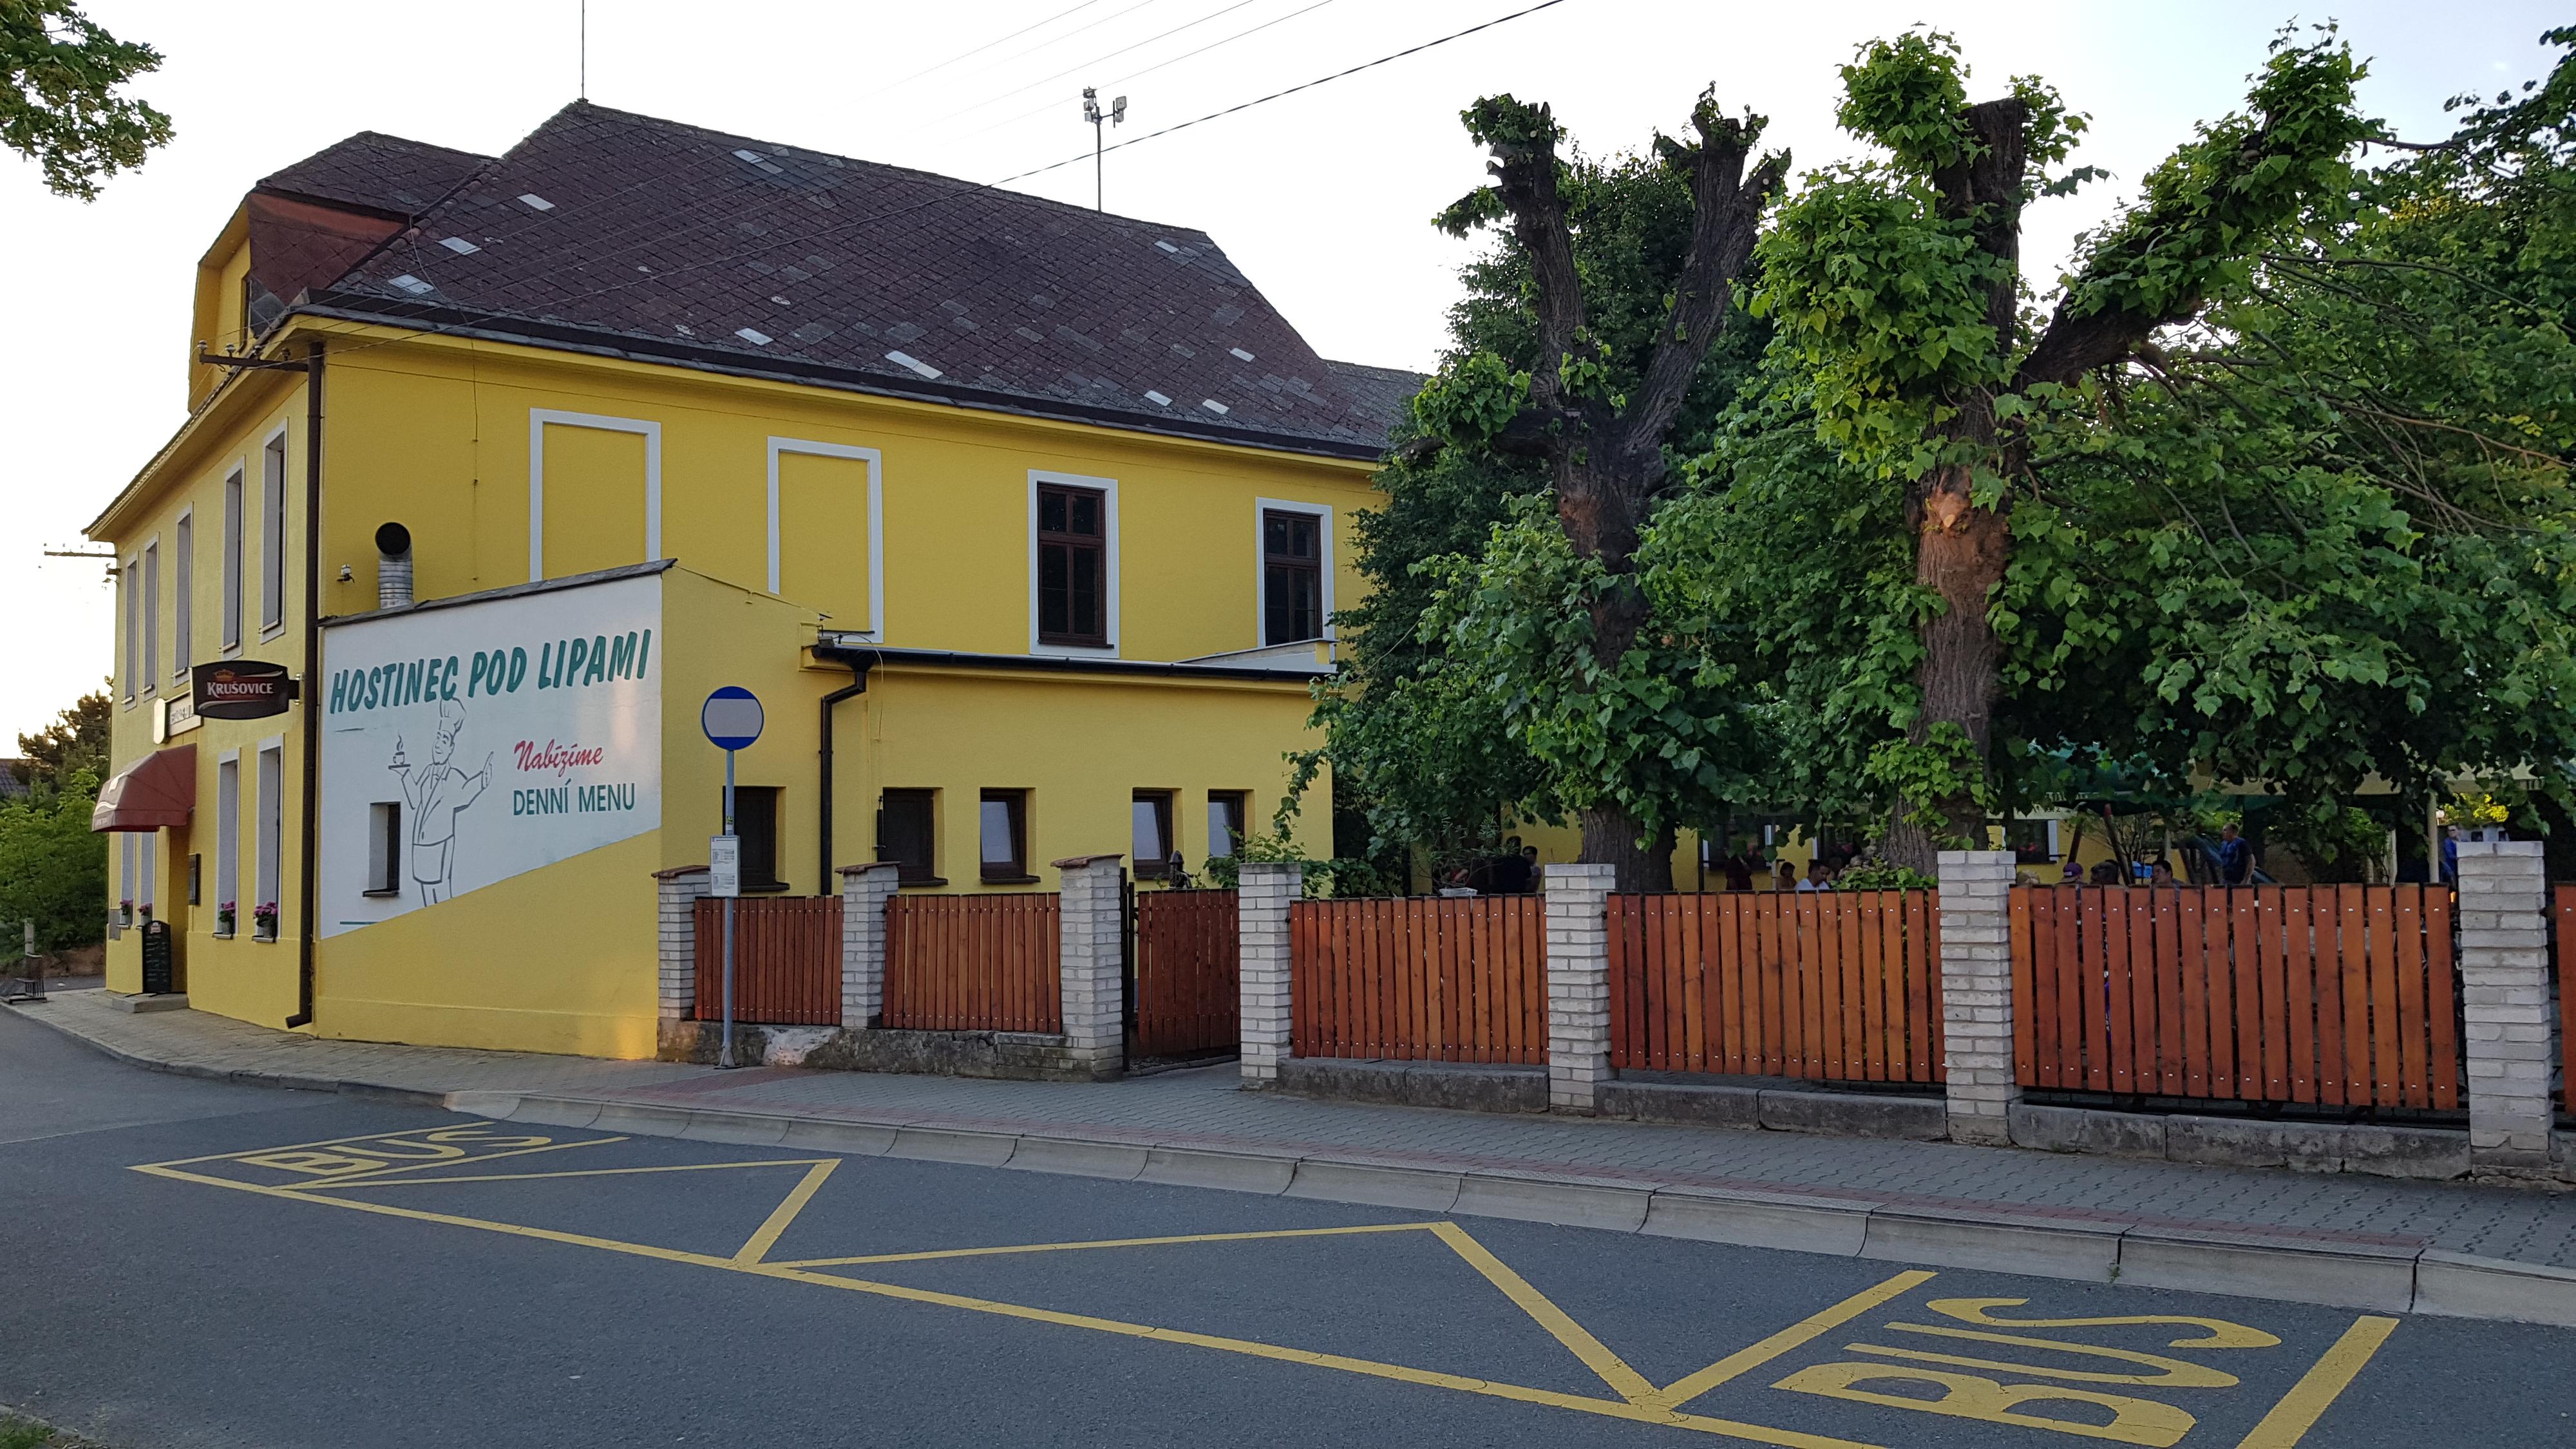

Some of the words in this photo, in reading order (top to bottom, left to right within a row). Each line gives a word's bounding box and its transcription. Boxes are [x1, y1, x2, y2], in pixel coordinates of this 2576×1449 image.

[207, 681, 274, 698] KRUŠOVICE
[330, 656, 459, 714] HOSTINEC
[468, 647, 527, 698] POD
[538, 629, 651, 689] LIPAMI
[514, 739, 603, 777] Nabízíme
[513, 778, 571, 816] DENNÍ
[579, 782, 635, 813] MENU
[234, 1132, 551, 1175] BUS
[1771, 1298, 2281, 1448] BUS
